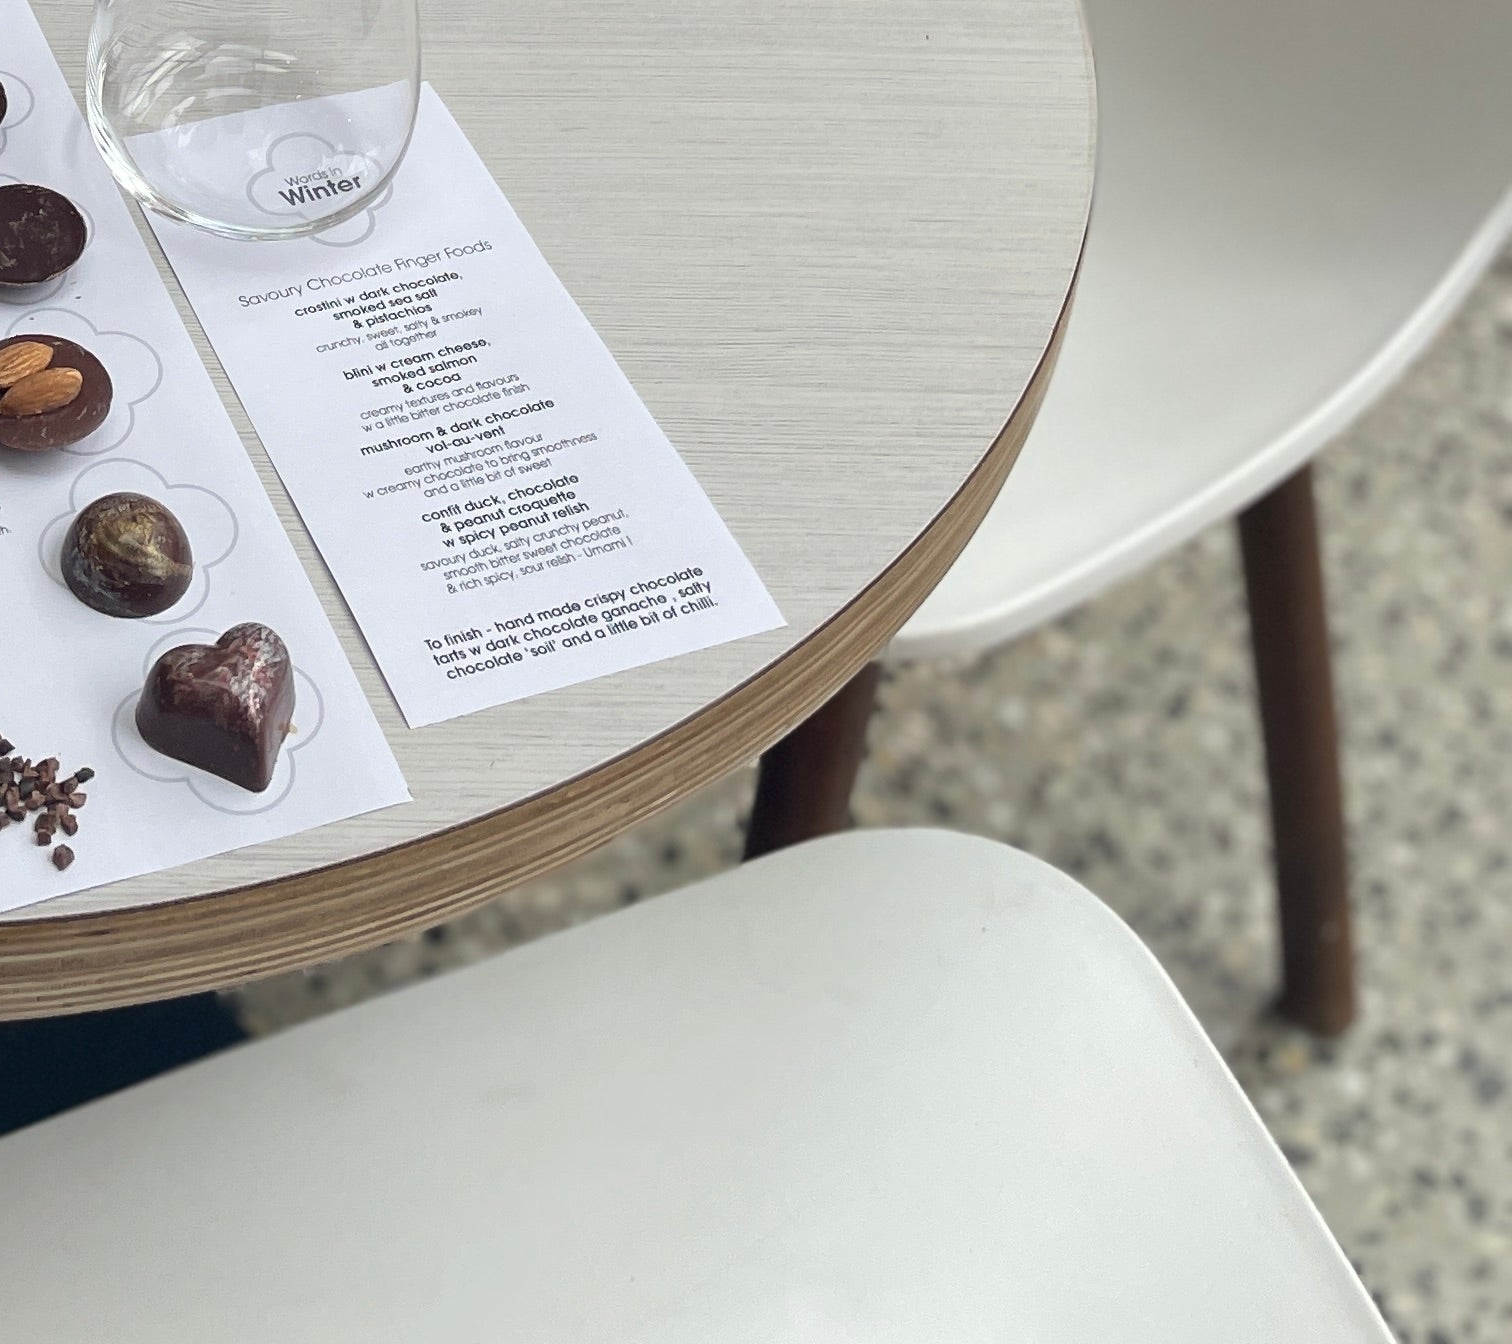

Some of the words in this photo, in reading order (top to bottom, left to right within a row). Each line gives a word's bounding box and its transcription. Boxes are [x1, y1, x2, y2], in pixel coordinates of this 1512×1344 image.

[277, 175, 362, 207] Winter
[283, 169, 329, 187] Words
[327, 166, 343, 177] in
[238, 284, 303, 308] Savoury
[306, 263, 393, 291] Chocolate
[393, 251, 442, 271] Finger
[443, 239, 493, 260] Foods
[294, 297, 343, 317] crostini
[342, 295, 356, 305] w
[358, 286, 391, 301] dark
[392, 272, 463, 294] chocolate,
[332, 299, 387, 321] smoked
[387, 295, 414, 308] sea
[414, 287, 438, 302] salt
[352, 319, 365, 329] &
[365, 304, 433, 329] pistachios
[403, 319, 429, 332] salty
[430, 315, 442, 326] &
[441, 306, 483, 323] smokey
[342, 364, 374, 381] blini
[374, 362, 387, 373] w
[390, 351, 436, 369] cream
[437, 338, 491, 357] cheese,
[374, 339, 390, 351] all
[388, 329, 438, 347] together
[371, 365, 427, 388] smoked
[427, 355, 478, 374] salmon
[402, 383, 415, 394] &
[416, 372, 462, 391] cocoa
[359, 402, 404, 421] creamy
[404, 391, 451, 409] textures
[450, 383, 476, 398] and
[475, 373, 520, 391] flavours
[360, 423, 373, 433] w
[374, 420, 385, 430] a
[384, 414, 410, 427] little
[408, 406, 441, 421] bitter
[442, 391, 502, 413] chocolate
[501, 383, 531, 397] finish
[360, 431, 435, 457] mushroom
[435, 426, 449, 437] &
[449, 417, 483, 433] dark
[484, 399, 555, 424] chocolate
[425, 424, 506, 454] vol-au-vent
[362, 489, 375, 499] w
[376, 478, 422, 496] creamy
[423, 462, 484, 485] chocolate
[483, 459, 499, 469] to
[497, 451, 532, 466] bring
[530, 432, 598, 458] smoothness
[403, 460, 442, 476] earthy
[442, 444, 504, 466] mushroom
[503, 433, 544, 450] flavour
[421, 503, 462, 523] confit
[464, 494, 507, 512] duck,
[507, 474, 579, 501] chocolate
[423, 483, 450, 498] and
[449, 482, 461, 492] a
[458, 476, 485, 489] little
[484, 470, 503, 483] bit
[503, 465, 517, 478] of
[517, 457, 553, 475] sweet
[439, 522, 453, 534] &
[453, 507, 506, 533] peanut
[507, 490, 577, 516] croquette
[441, 538, 455, 548] w
[458, 527, 496, 546] spicy
[498, 511, 551, 537] peanut
[551, 501, 590, 520] relish
[420, 553, 467, 572] savoury
[503, 536, 531, 551] salty
[532, 522, 580, 543] crunchy
[443, 561, 489, 581] smooth
[487, 553, 522, 569] bitter
[521, 541, 559, 560] sweet
[559, 526, 622, 550] chocolate
[446, 583, 459, 595] &
[458, 577, 483, 592] rich
[519, 561, 545, 576] sour
[545, 552, 577, 569] relish
[581, 537, 627, 558] Umami
[423, 638, 443, 651] To
[443, 627, 484, 647] finish
[493, 612, 535, 633] hand
[536, 602, 582, 622] made
[584, 589, 626, 608] crispy
[629, 567, 704, 595] chocolate
[432, 649, 467, 666] tarts
[467, 645, 482, 656] w
[485, 634, 521, 652] dark
[522, 614, 599, 642] chocolate
[601, 594, 668, 623] ganache
[677, 581, 711, 598] salty
[446, 651, 524, 680] chocolate
[561, 630, 593, 648] and
[594, 628, 607, 639] a
[605, 619, 639, 636] little
[638, 611, 661, 627] bit
[662, 605, 679, 620] of
[680, 595, 719, 615] chilli.
